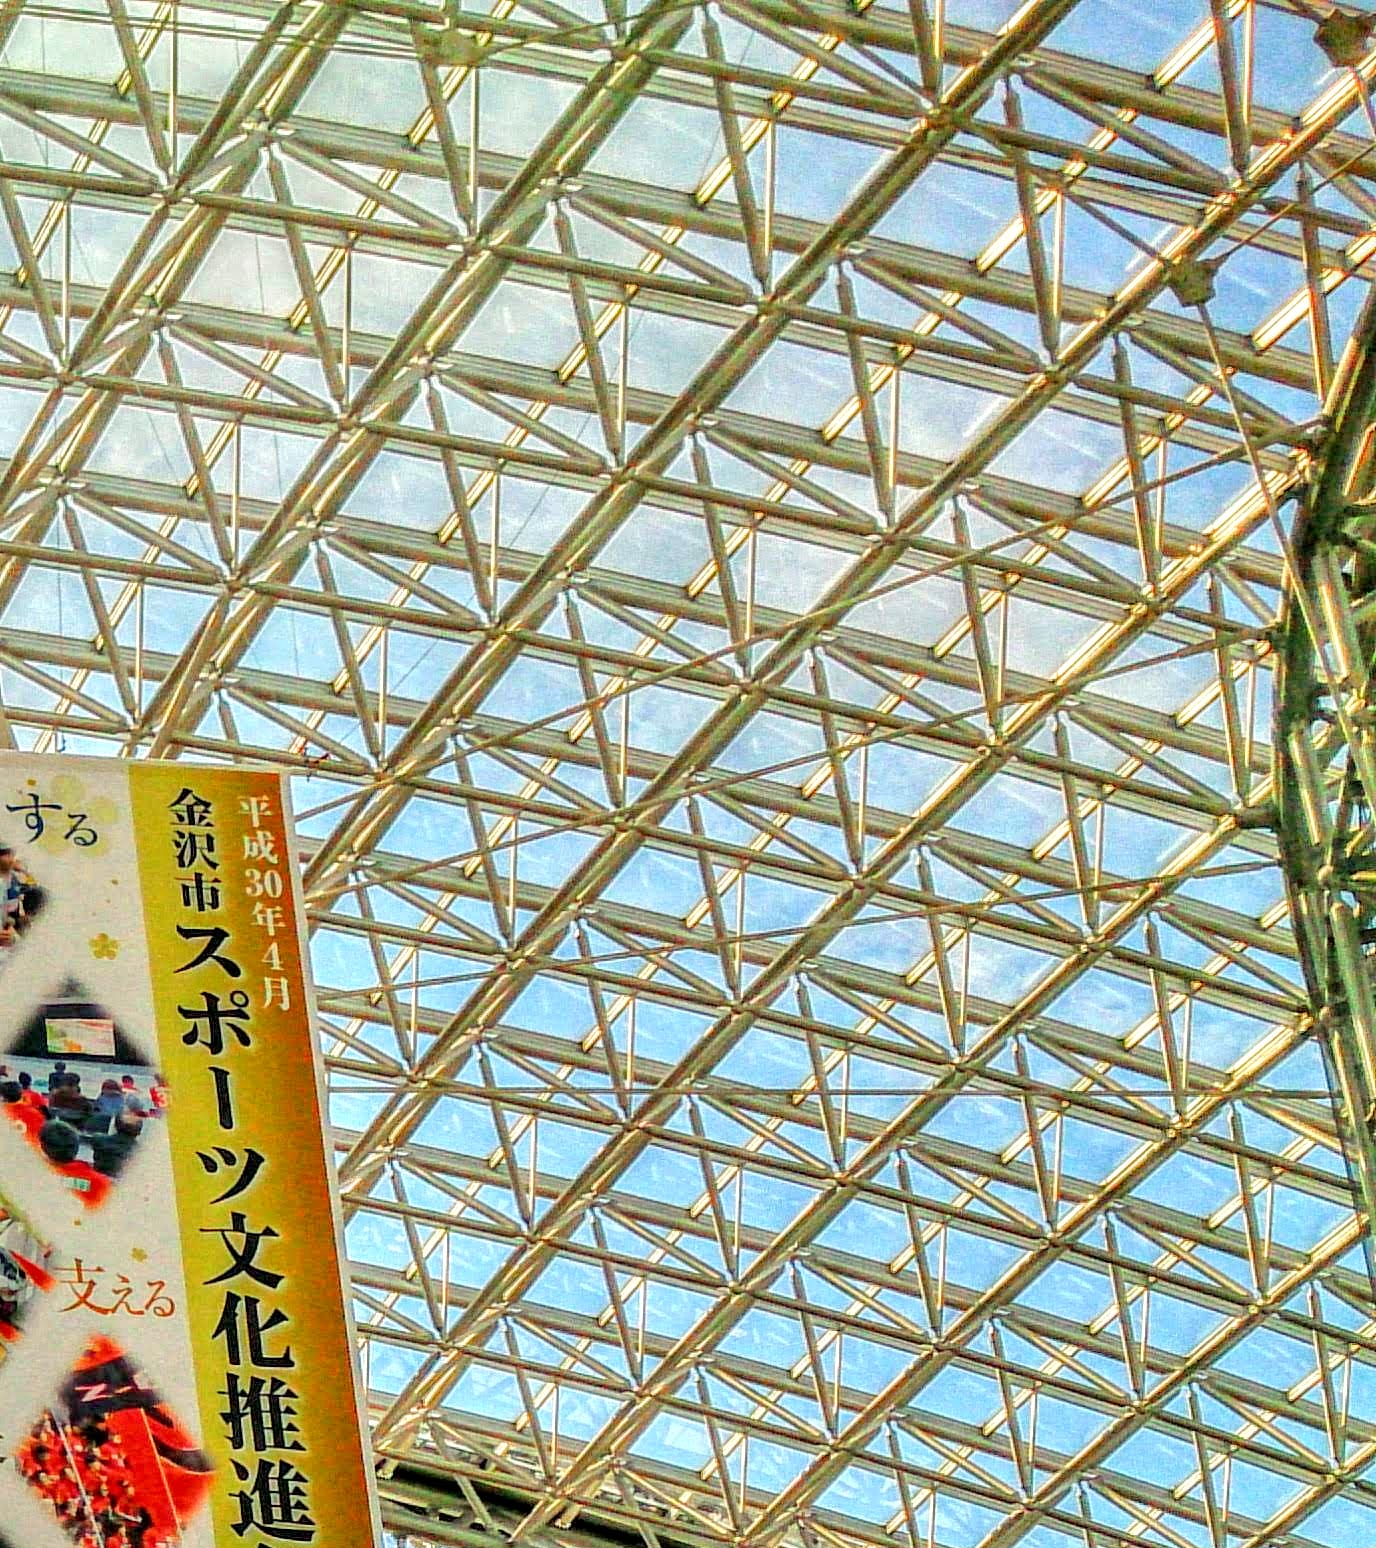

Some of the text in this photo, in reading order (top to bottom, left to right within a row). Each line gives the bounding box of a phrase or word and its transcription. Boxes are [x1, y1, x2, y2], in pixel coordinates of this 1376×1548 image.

[6, 792, 99, 847] する
[237, 794, 290, 1012] 平成30年4月
[57, 1257, 177, 1318] 支える
